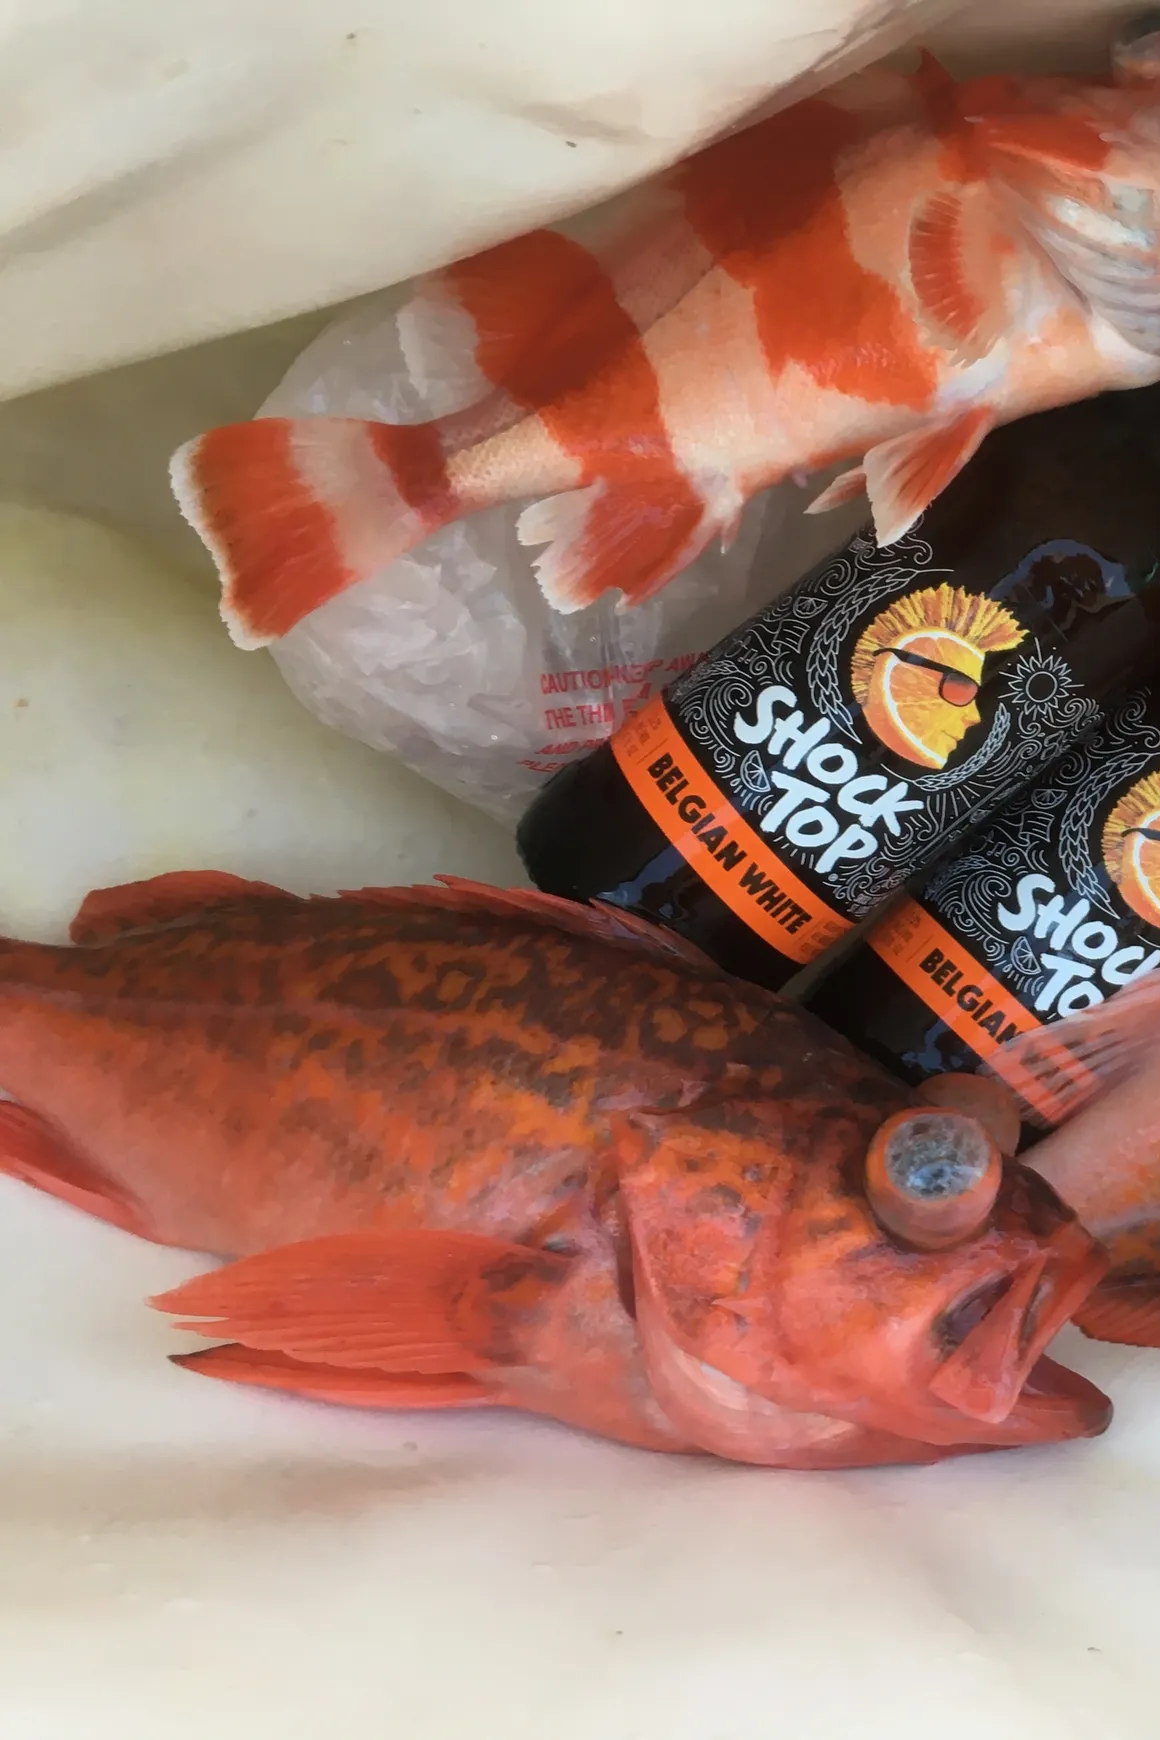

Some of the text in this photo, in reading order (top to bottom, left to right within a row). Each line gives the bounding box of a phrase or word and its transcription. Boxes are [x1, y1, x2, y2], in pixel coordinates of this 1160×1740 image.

[544, 707, 576, 730] THE
[734, 685, 924, 836] SHOCK
[646, 752, 812, 935] BELGIAN WHITE
[1034, 953, 1104, 1021] TO
